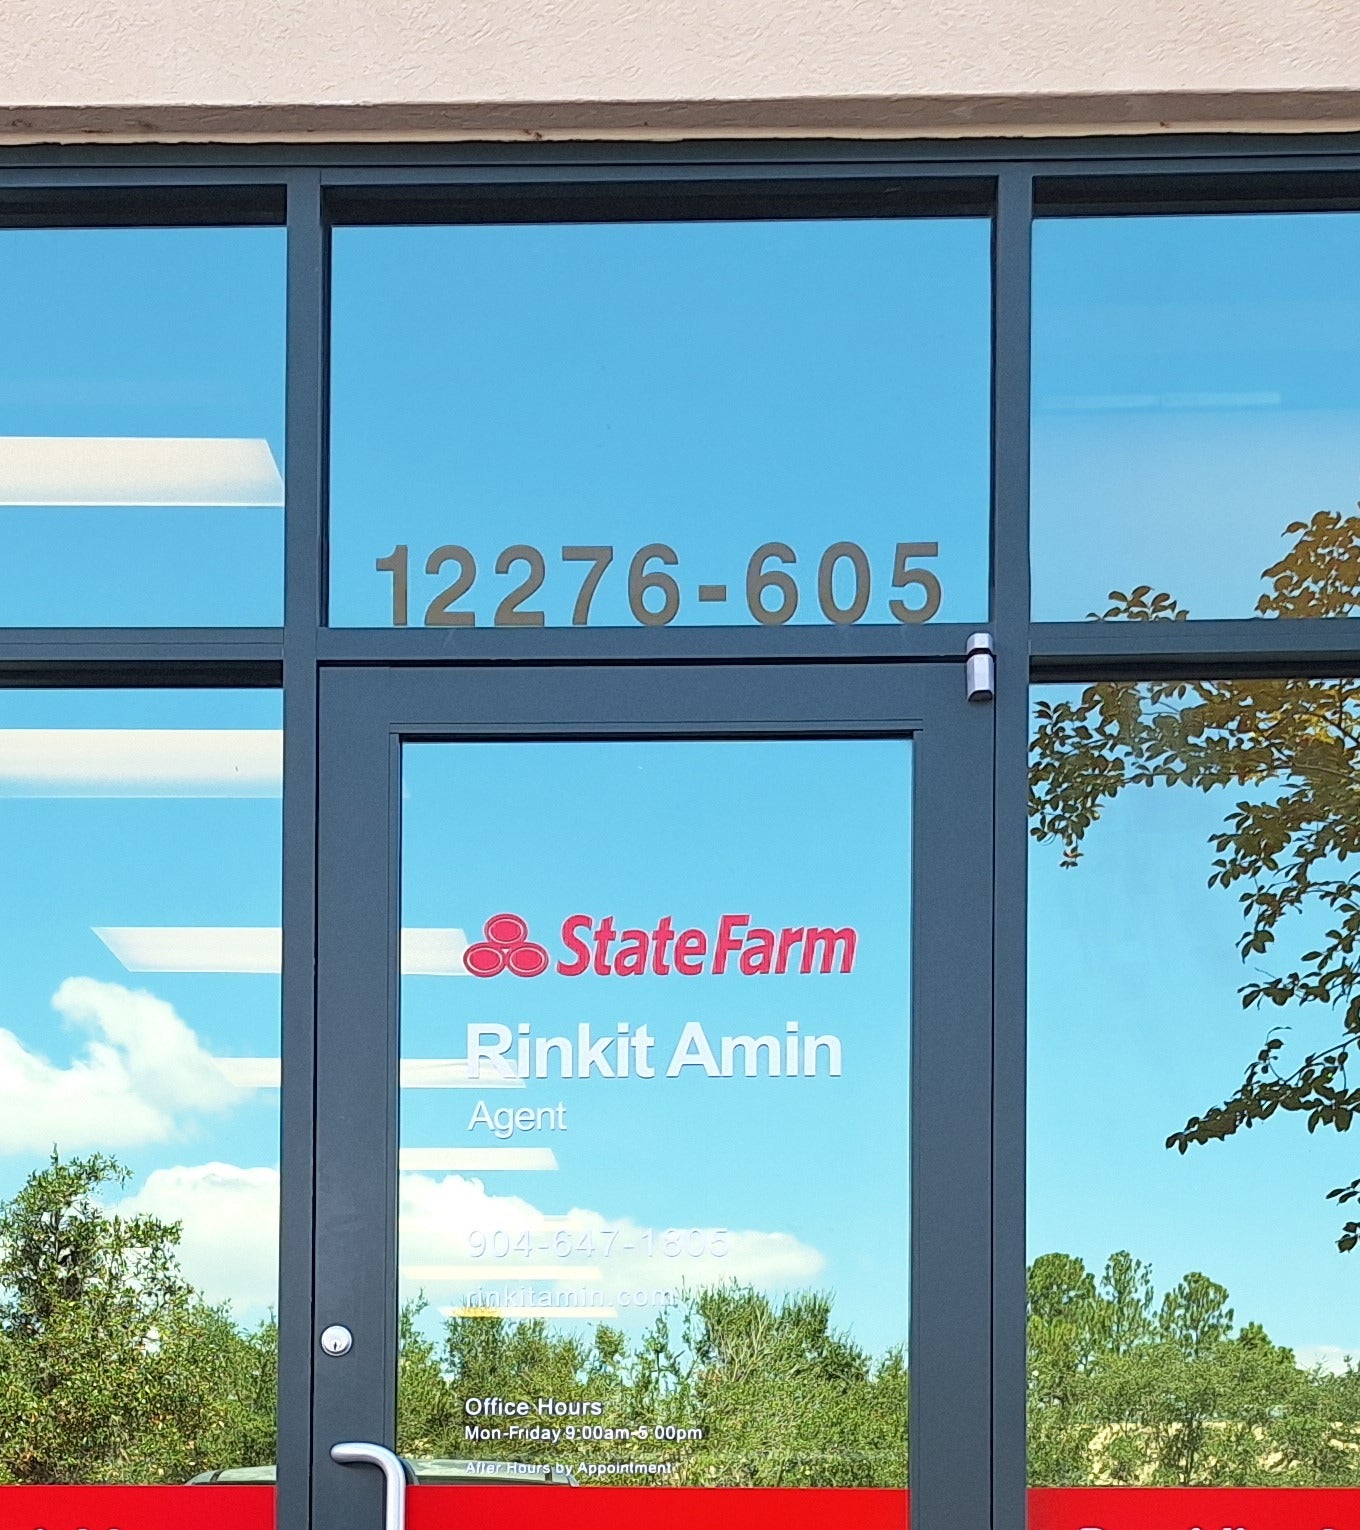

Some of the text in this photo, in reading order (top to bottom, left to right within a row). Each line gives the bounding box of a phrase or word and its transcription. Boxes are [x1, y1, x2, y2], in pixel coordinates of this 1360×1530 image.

[375, 541, 942, 627] 12276-605
[466, 1021, 842, 1079] Rinkit Amin
[467, 1100, 567, 1138] Agent
[468, 1228, 730, 1258] 904-647-1805
[466, 1286, 676, 1309] rinkitamin.com
[465, 1397, 603, 1416] Office Hours
[465, 1426, 560, 1443] Mon-Friday
[465, 1462, 673, 1477] After Hours by Appointment
